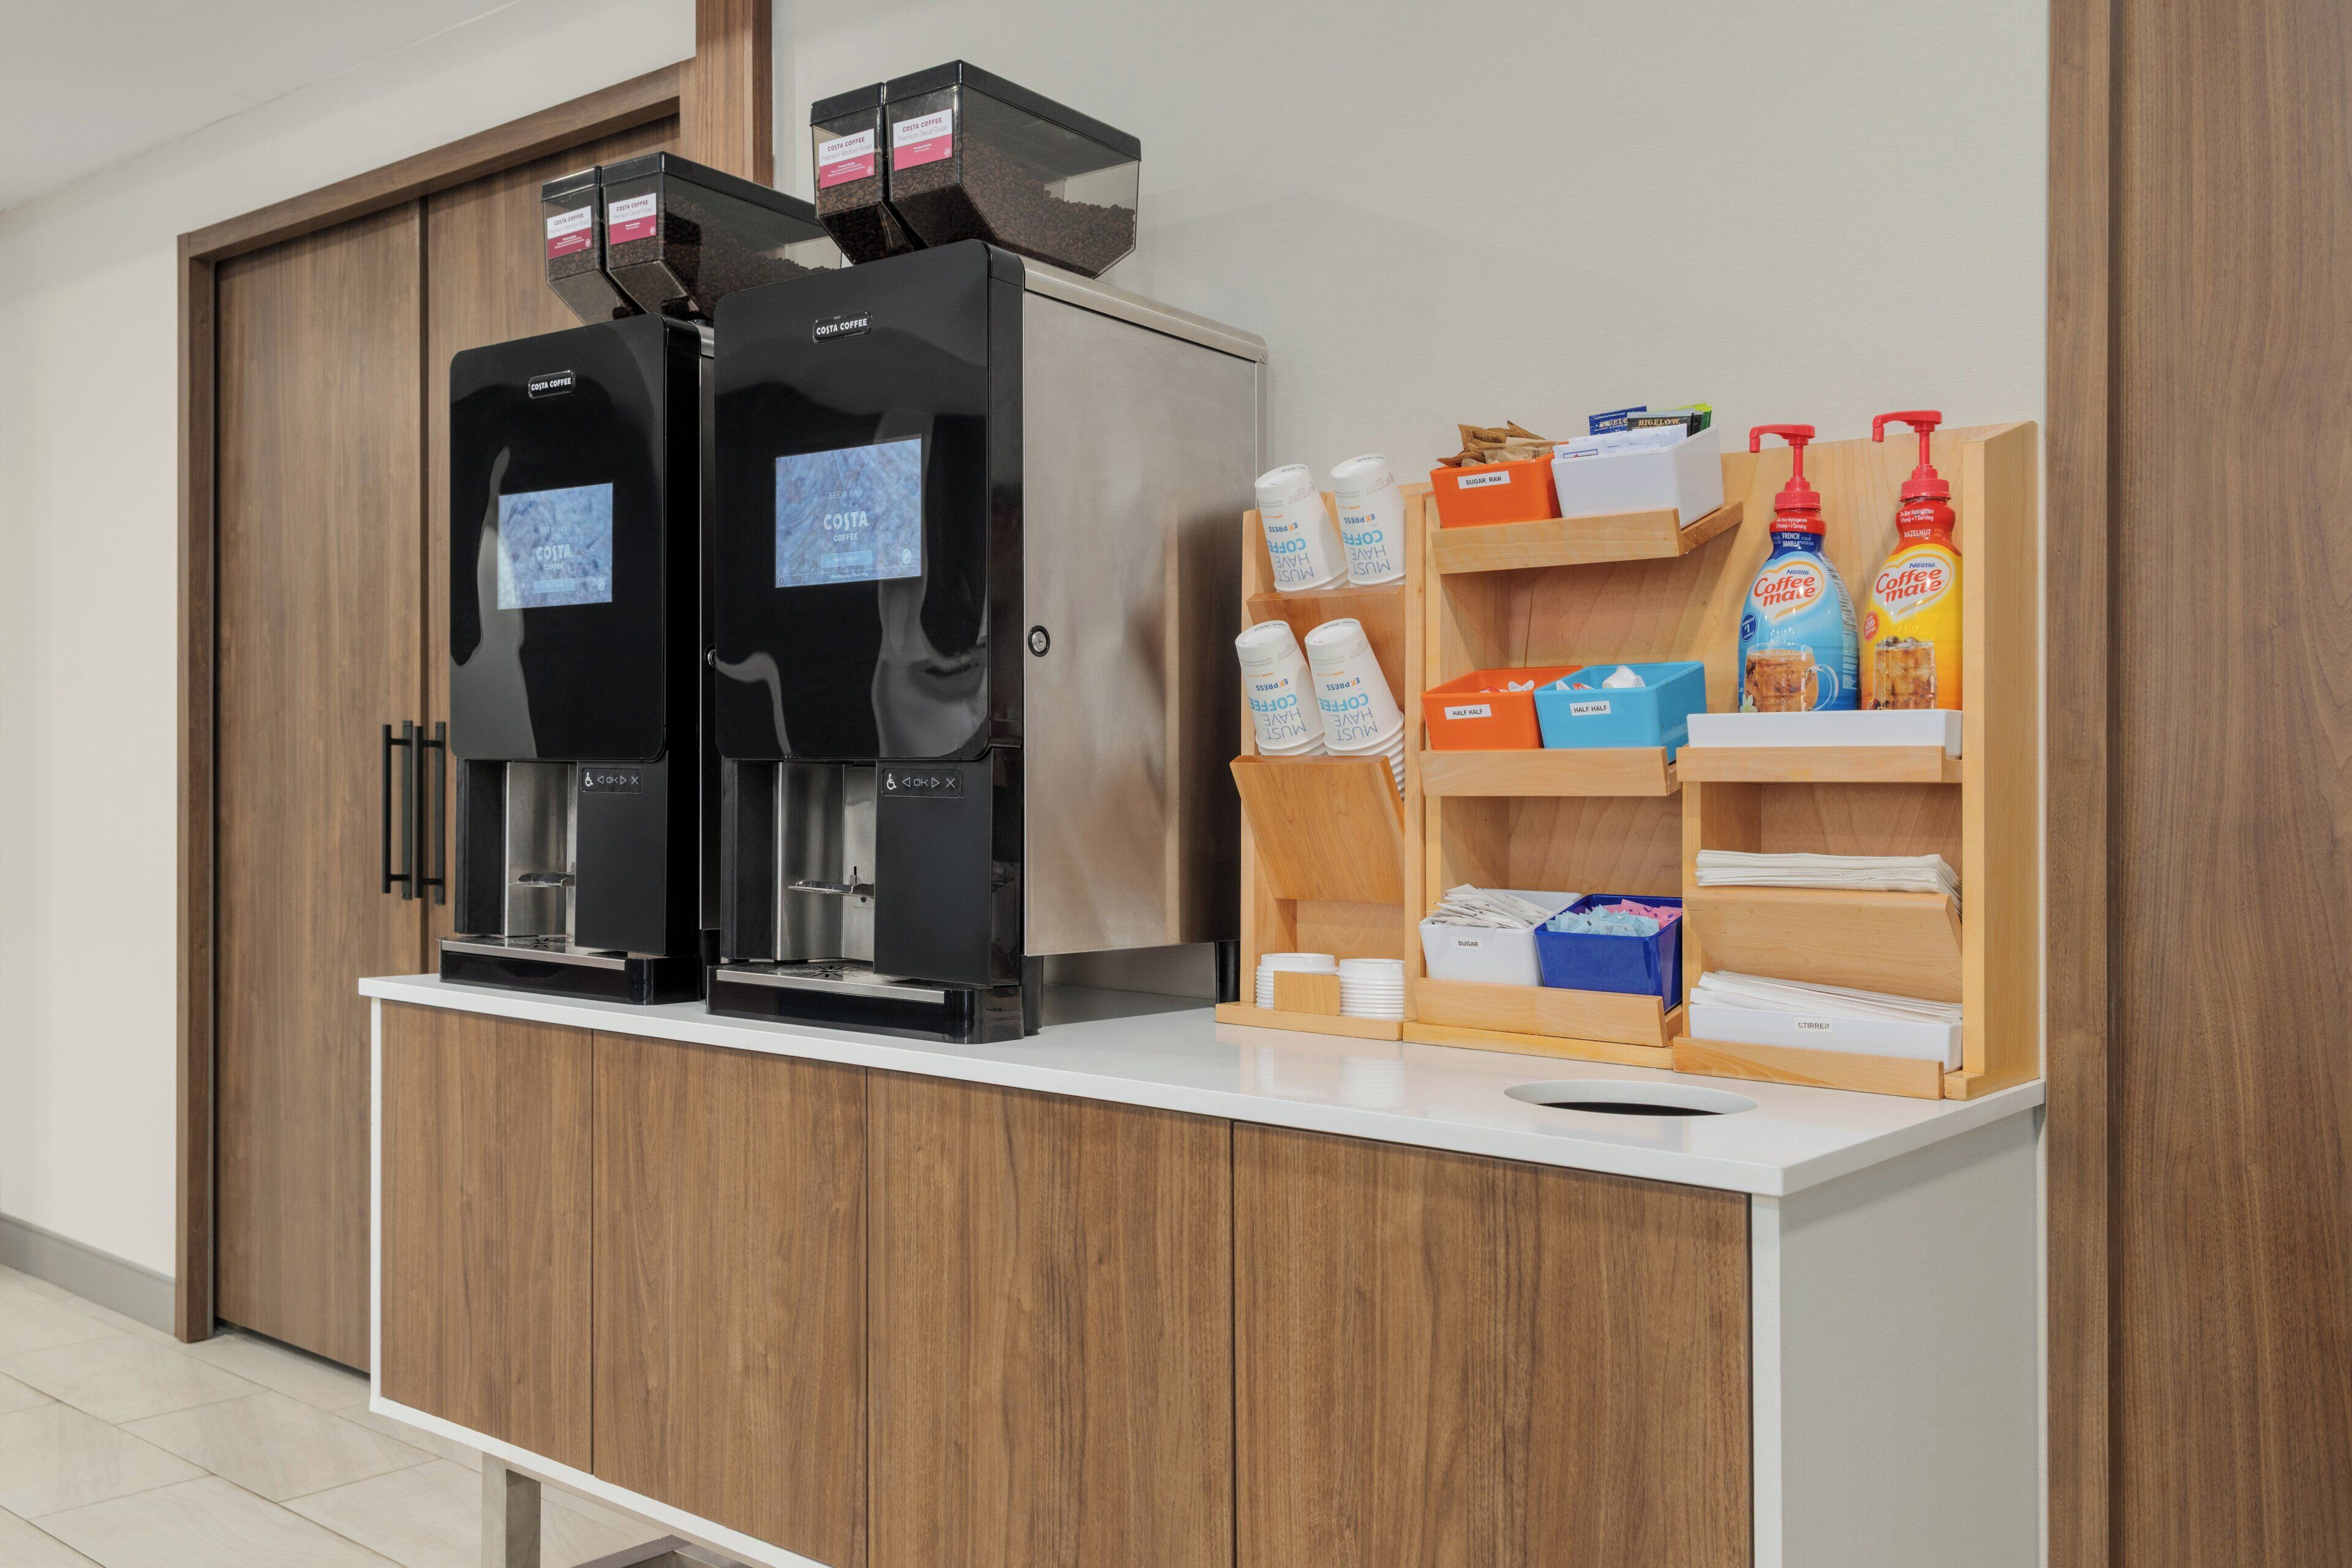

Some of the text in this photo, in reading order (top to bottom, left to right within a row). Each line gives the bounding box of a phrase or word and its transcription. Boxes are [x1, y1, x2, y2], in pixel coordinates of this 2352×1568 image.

[902, 117, 942, 132] COSTA COFFEE
[898, 133, 919, 143] Premium
[934, 125, 948, 134] Roast
[827, 137, 865, 151] COSTA COFFEE
[821, 152, 840, 162] Premium
[631, 200, 648, 208] COFFEE
[568, 213, 584, 222] COFFEE
[816, 318, 867, 335] COSTA COFFEE
[531, 377, 571, 391] COSTA COFFEE
[1599, 418, 1627, 428] BIGELO
[828, 489, 863, 500] BREW BAR
[823, 510, 868, 531] COSTA
[834, 533, 858, 541] COFFEE
[1341, 530, 1383, 546] COFFE
[1904, 529, 1931, 538] HAZELNUT
[537, 544, 571, 561] COSTA
[1267, 538, 1306, 553] COFFE
[1754, 576, 1815, 597] Coffee
[1875, 569, 1942, 594] Coffee
[1763, 587, 1815, 607] mate
[1885, 580, 1942, 603] mate
[1248, 693, 1297, 712] COFFEE
[1317, 693, 1369, 712] COFFEE
